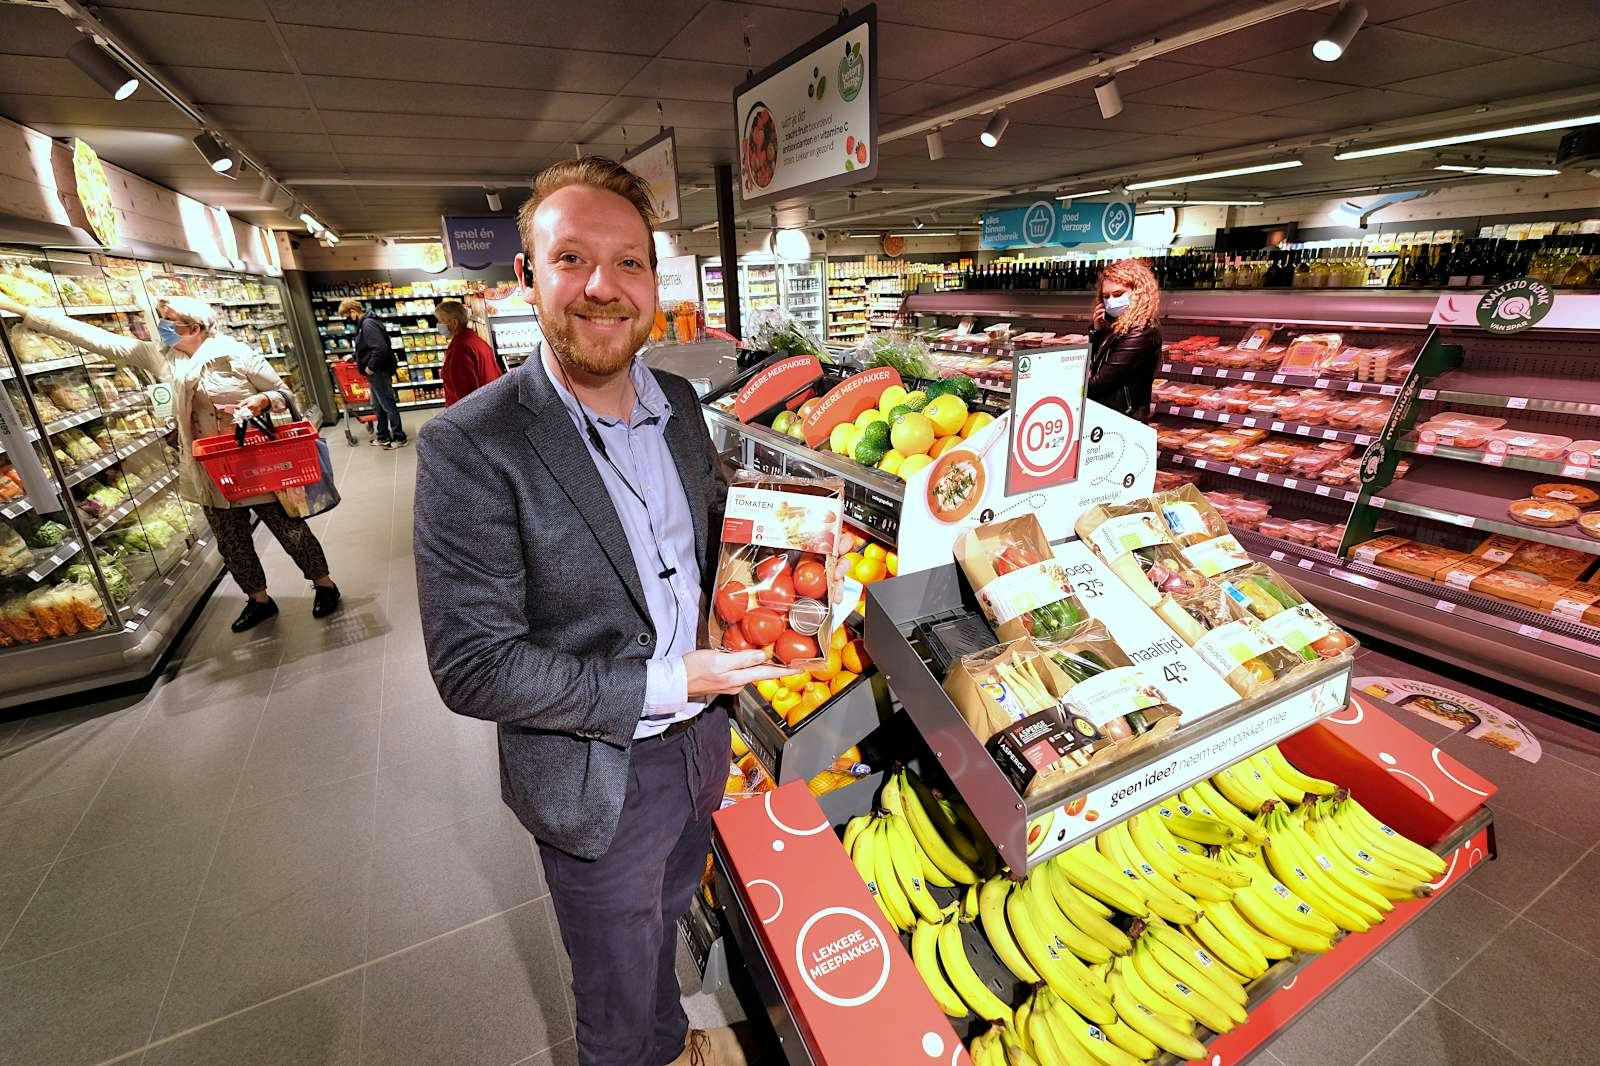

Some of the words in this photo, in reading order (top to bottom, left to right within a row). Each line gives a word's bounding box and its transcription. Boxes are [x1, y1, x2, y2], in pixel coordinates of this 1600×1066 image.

[985, 216, 1000, 225] alles
[1062, 213, 1080, 223] goed
[454, 227, 478, 239] snel
[479, 227, 495, 239] én
[985, 225, 1006, 234] binnen
[1061, 222, 1091, 232] verzorgd
[456, 240, 491, 251] lekker
[1481, 280, 1528, 310] MAALTIJD
[1528, 282, 1550, 306] GEMAK
[1490, 321, 1506, 332] VAN
[1505, 320, 1529, 332] SPAR
[739, 374, 769, 405] LEKKERE
[768, 358, 812, 380] MEEPAKKER
[809, 389, 842, 427] LEKKERE
[841, 370, 891, 394] MEEPAKKER
[735, 498, 774, 509] TOMATEN
[1018, 720, 1048, 740] ASPERGE
[1000, 743, 1027, 774] ASPERGE
[1110, 780, 1142, 808] geen
[1144, 761, 1178, 787] idee?
[1178, 748, 1210, 770] neem
[1212, 738, 1232, 756] een
[1233, 722, 1266, 748] pakket
[1266, 710, 1288, 728] mee
[812, 929, 865, 963] LEKKERE
[809, 937, 880, 980] MEEPAKKER
